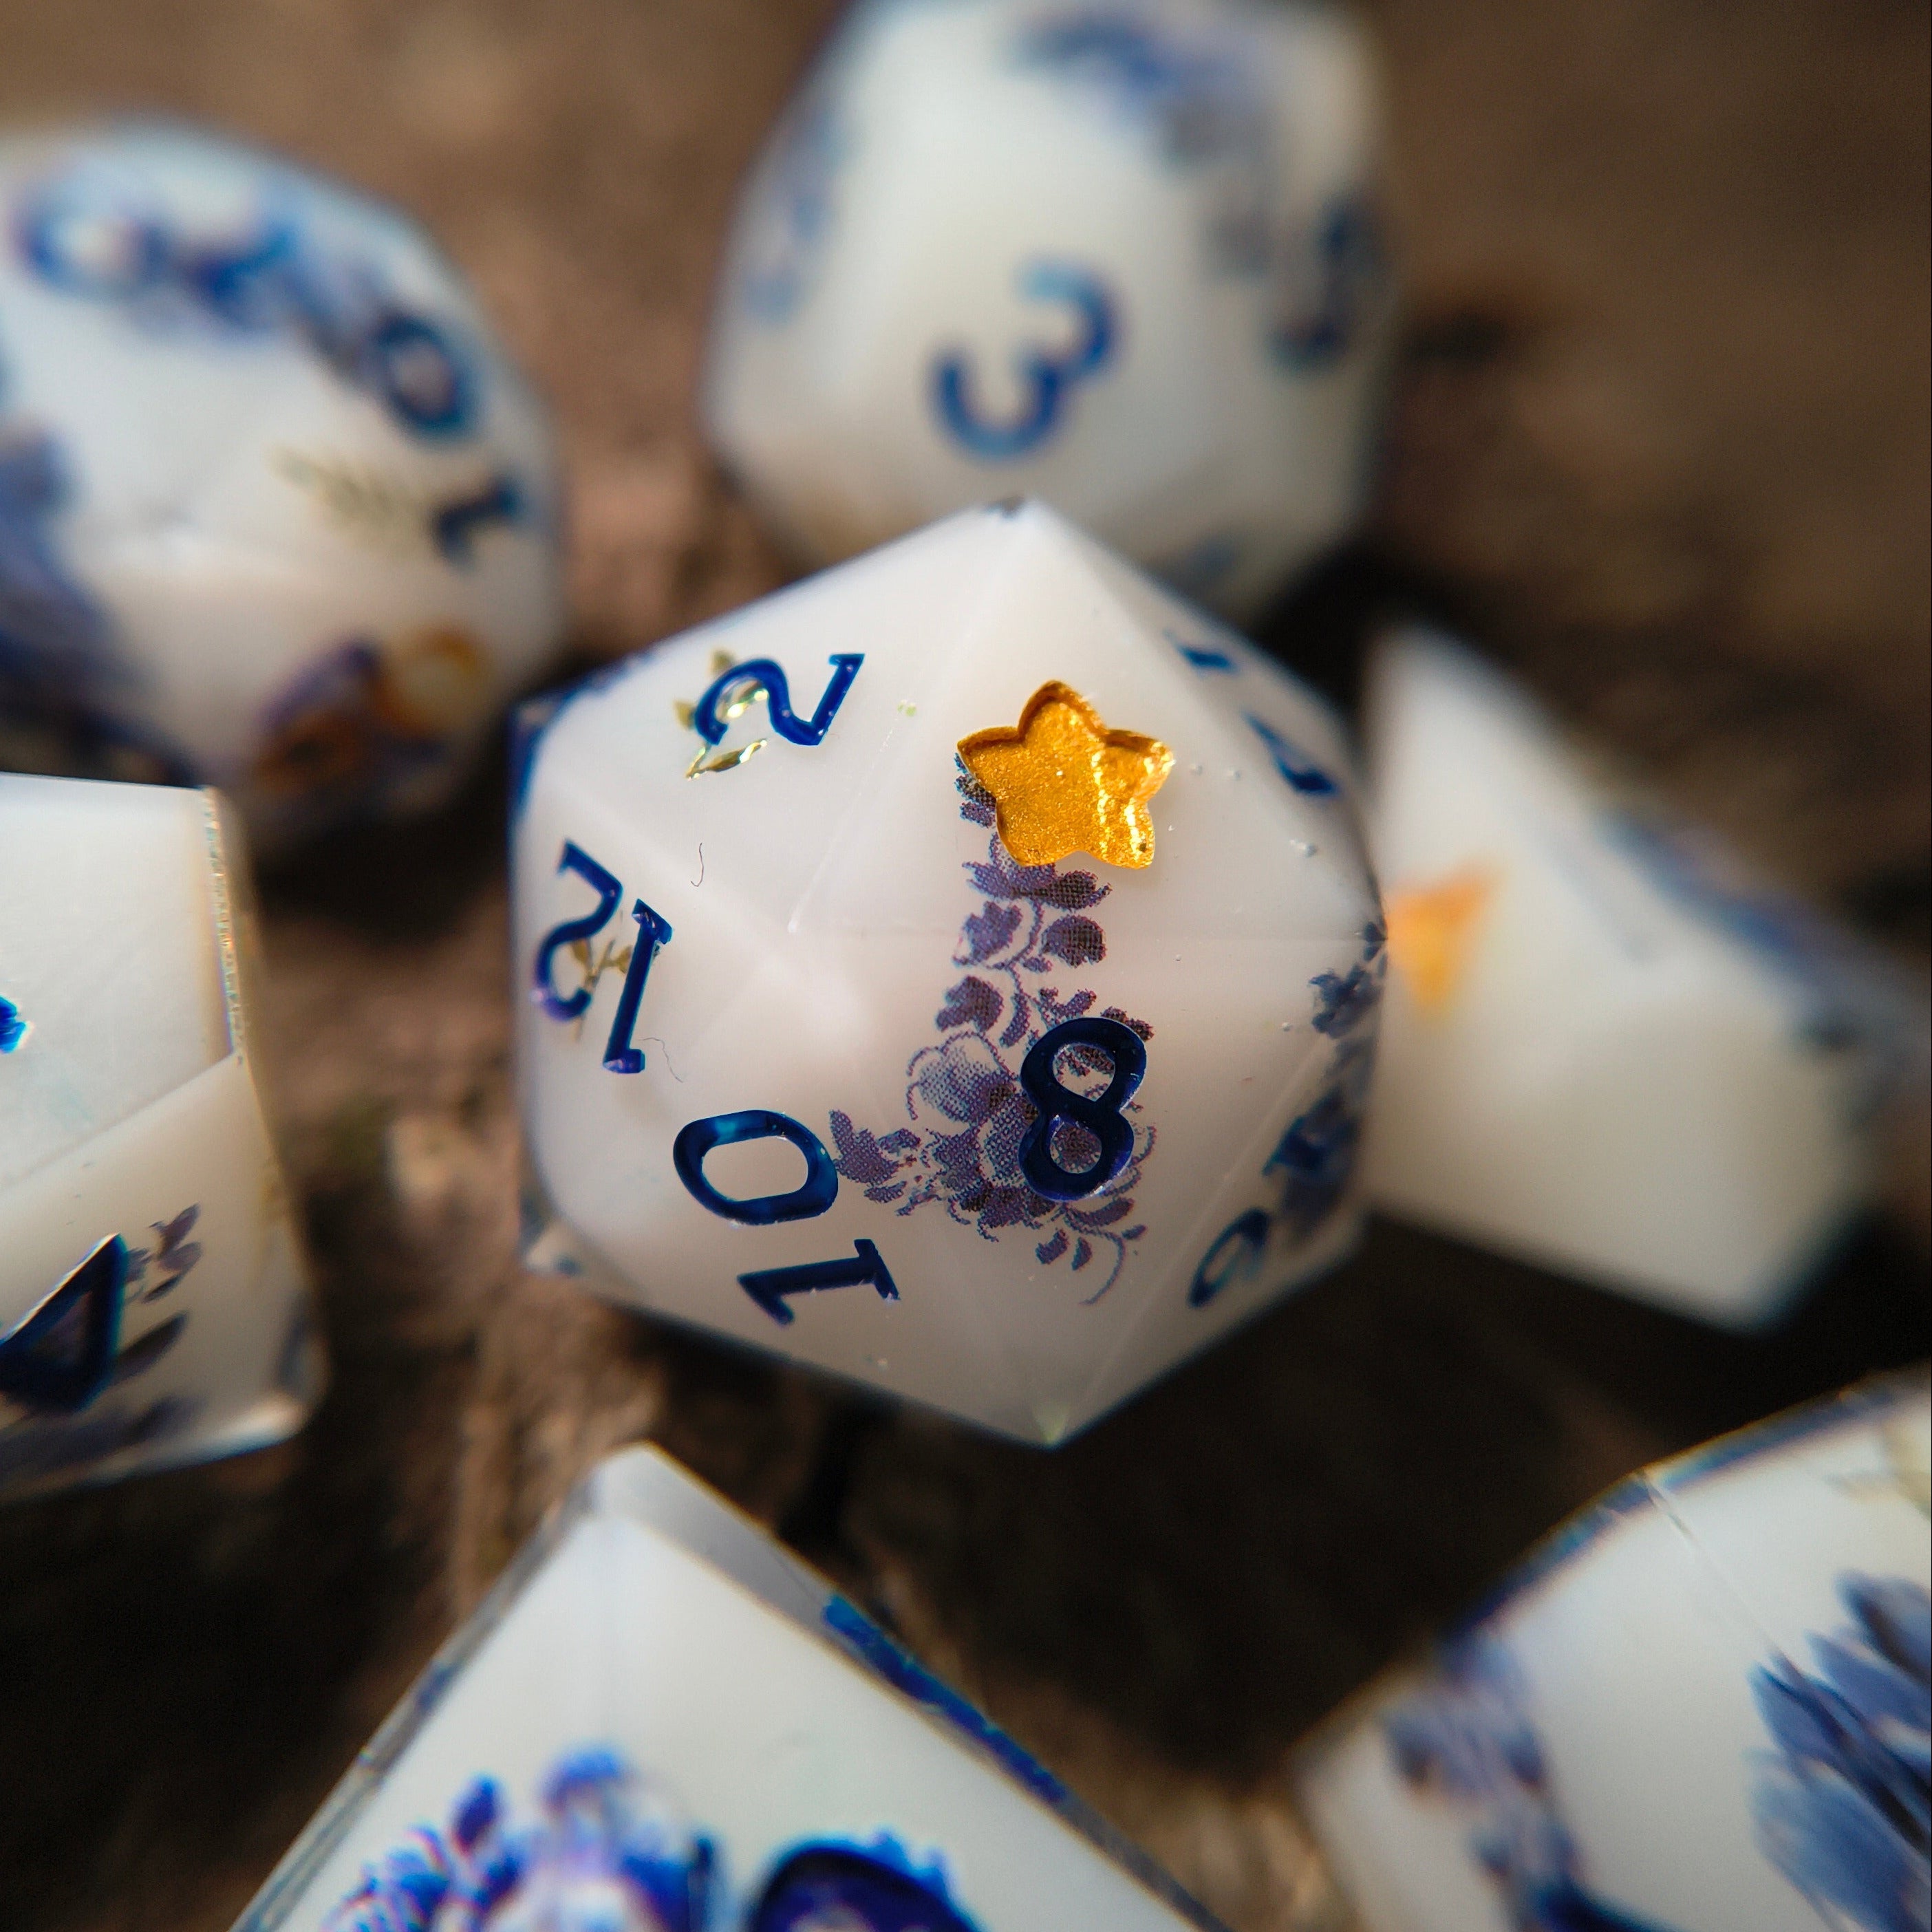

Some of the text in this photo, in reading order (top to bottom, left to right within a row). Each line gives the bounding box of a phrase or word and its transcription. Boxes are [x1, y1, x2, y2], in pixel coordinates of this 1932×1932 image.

[930, 261, 1123, 463] 3
[694, 653, 865, 746] 2
[1018, 1017, 1147, 1201] 8
[673, 1109, 900, 1328] 10
